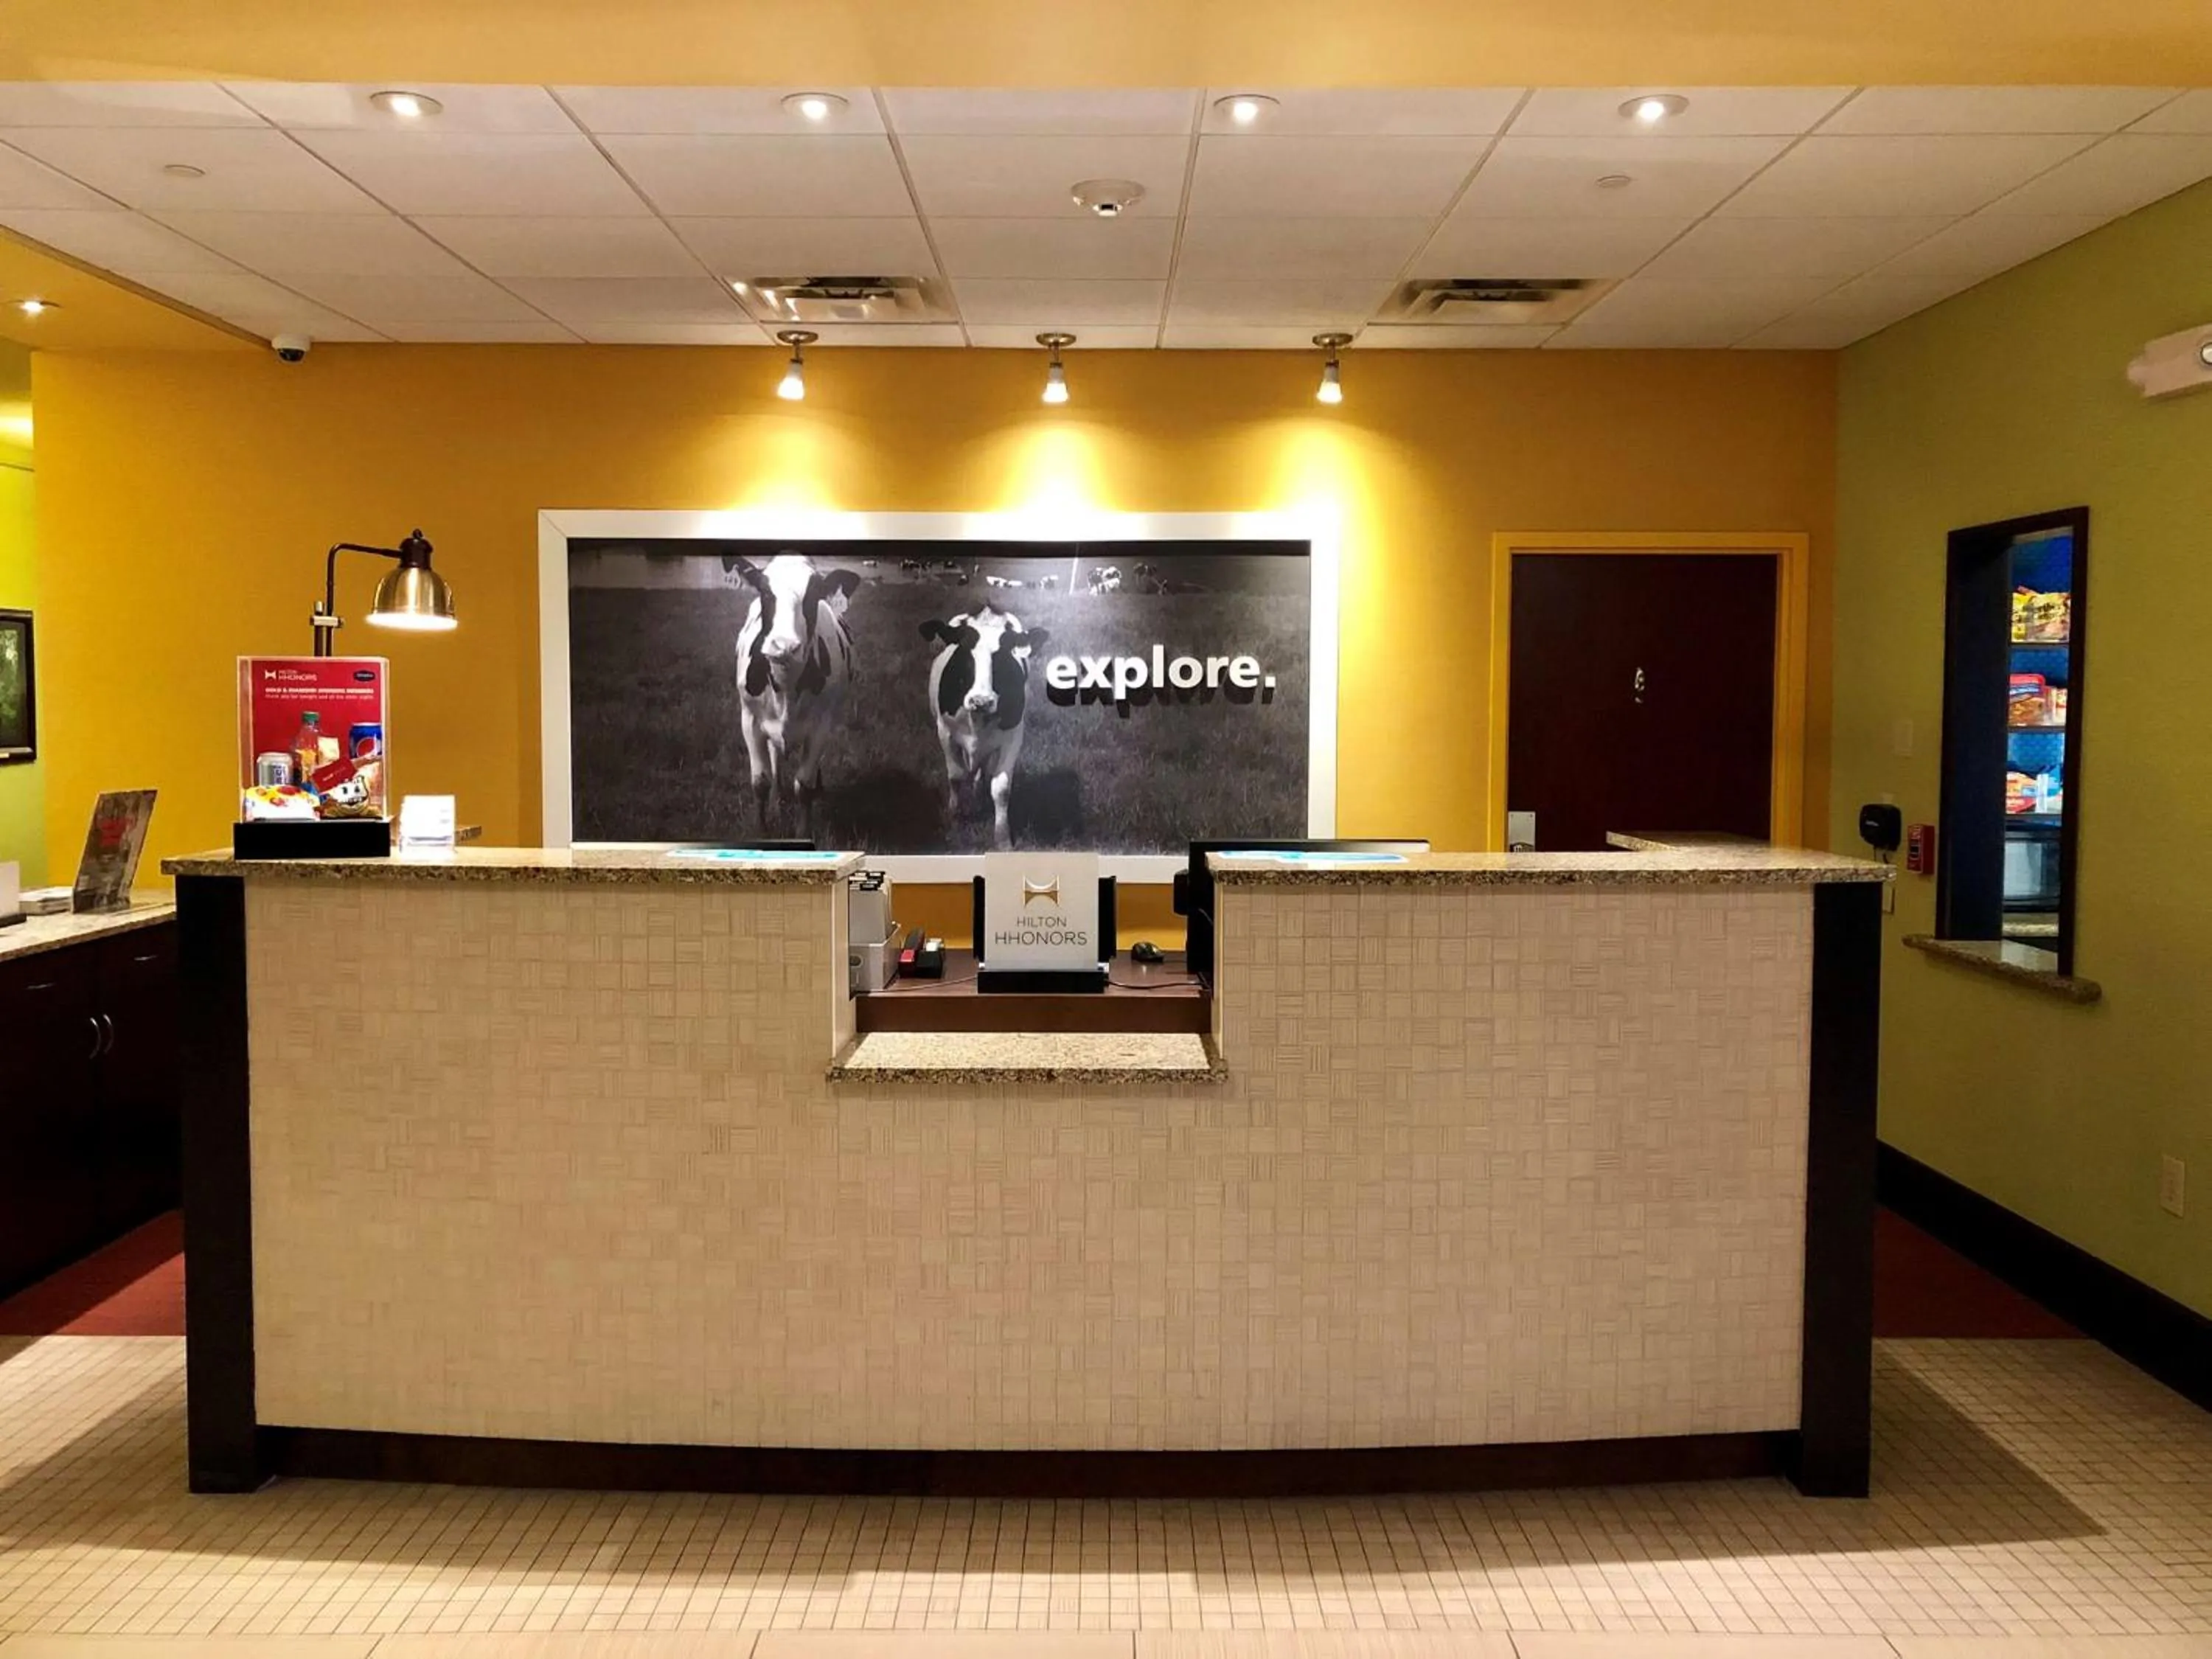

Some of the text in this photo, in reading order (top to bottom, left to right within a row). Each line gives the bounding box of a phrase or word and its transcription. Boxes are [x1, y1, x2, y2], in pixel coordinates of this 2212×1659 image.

[1046, 644, 1276, 700] explore.
[1017, 916, 1067, 928] HILTON
[995, 931, 1088, 945] HHONORS
